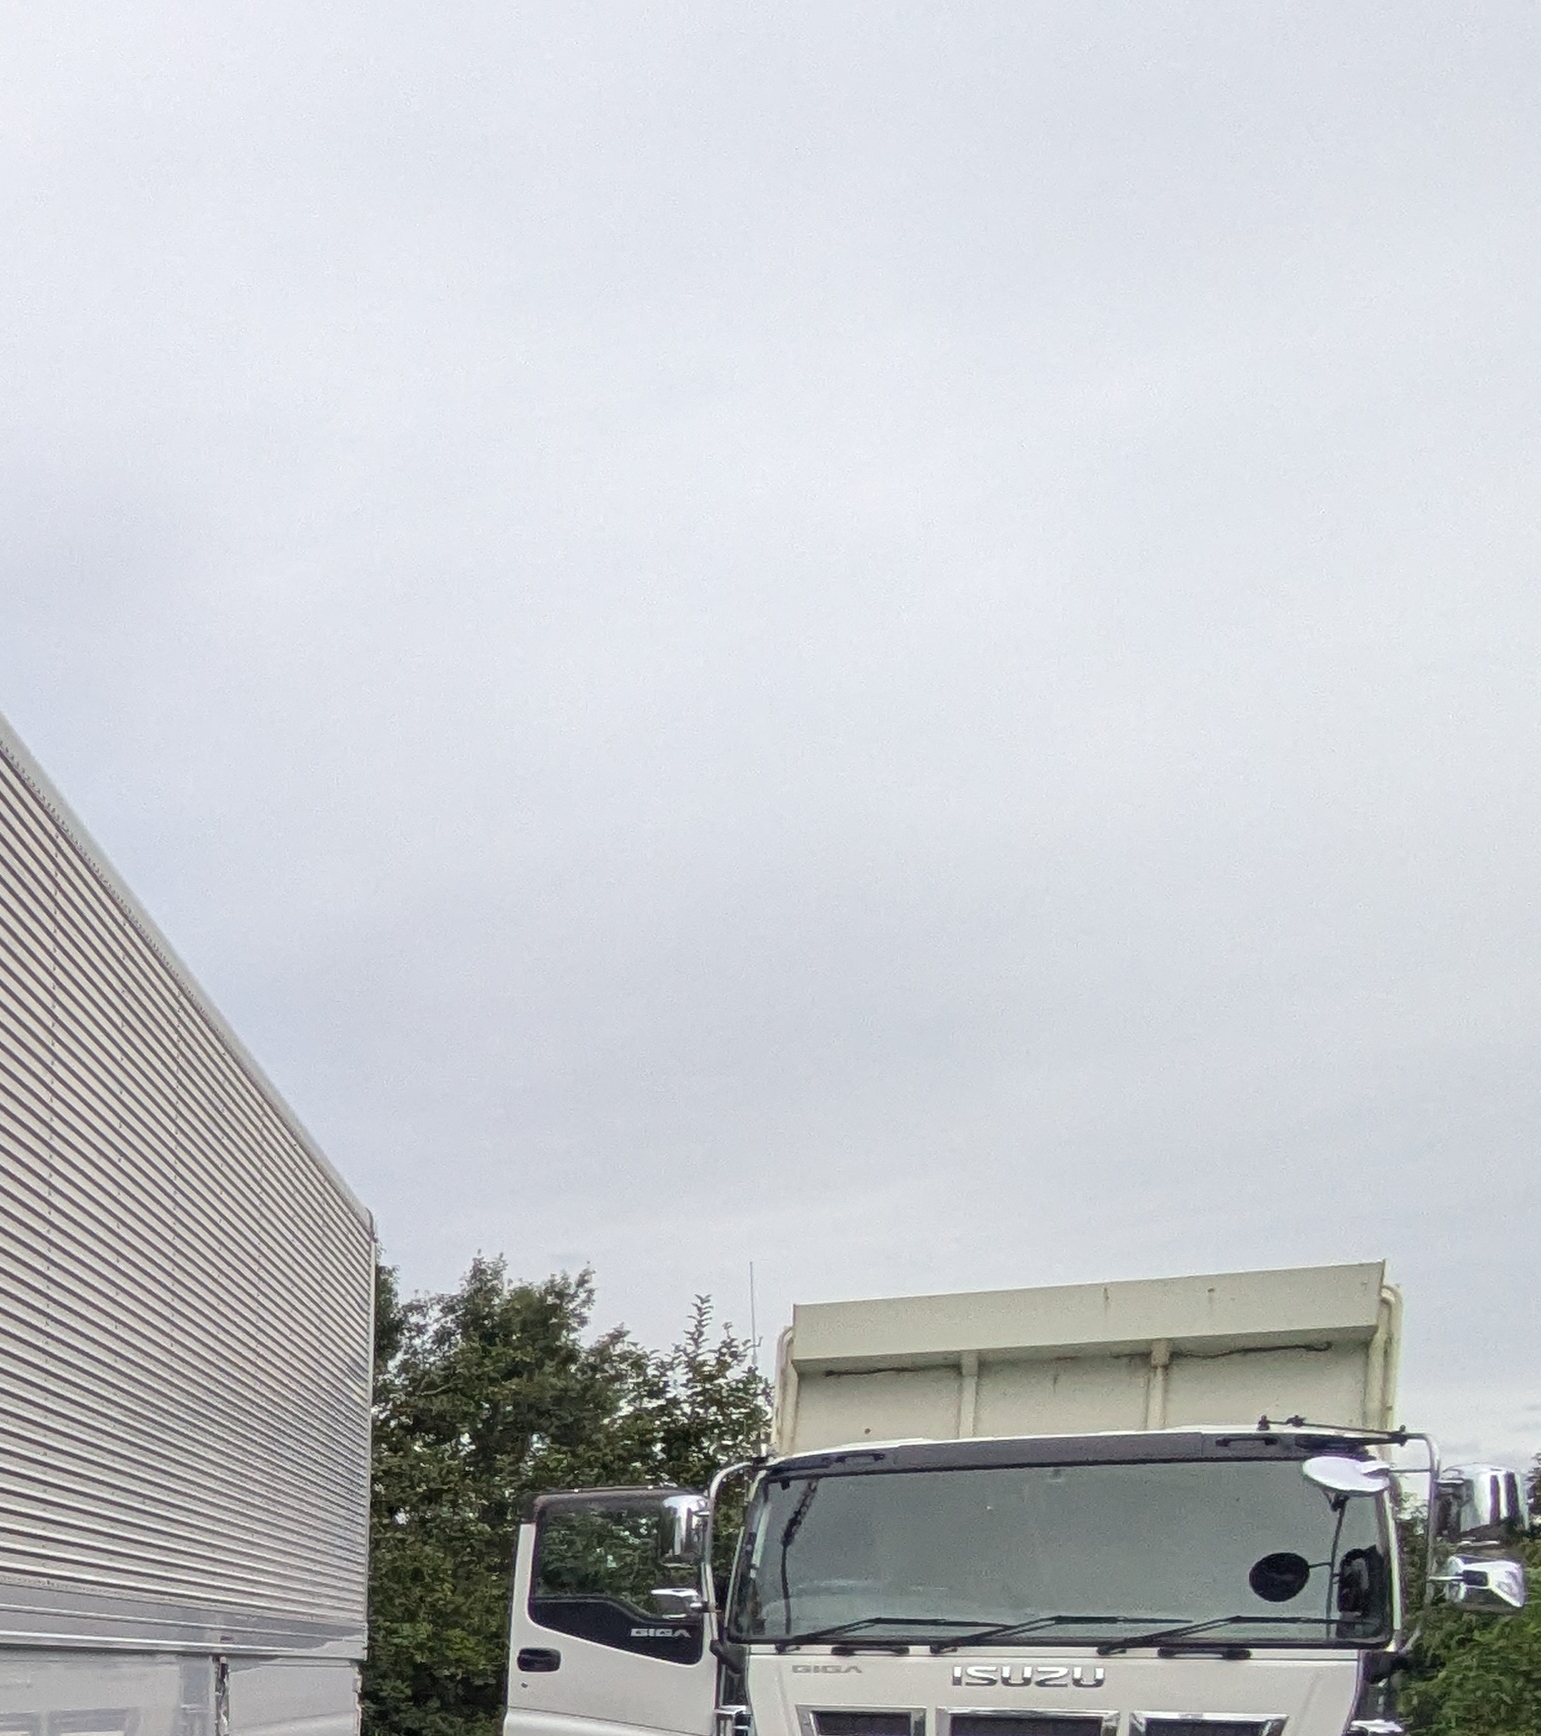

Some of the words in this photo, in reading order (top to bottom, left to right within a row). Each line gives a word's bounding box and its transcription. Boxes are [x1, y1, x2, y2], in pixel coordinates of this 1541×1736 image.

[630, 1628, 692, 1639] GIGA
[791, 1664, 863, 1674] GIGA
[951, 1664, 1106, 1689] ISUZU
